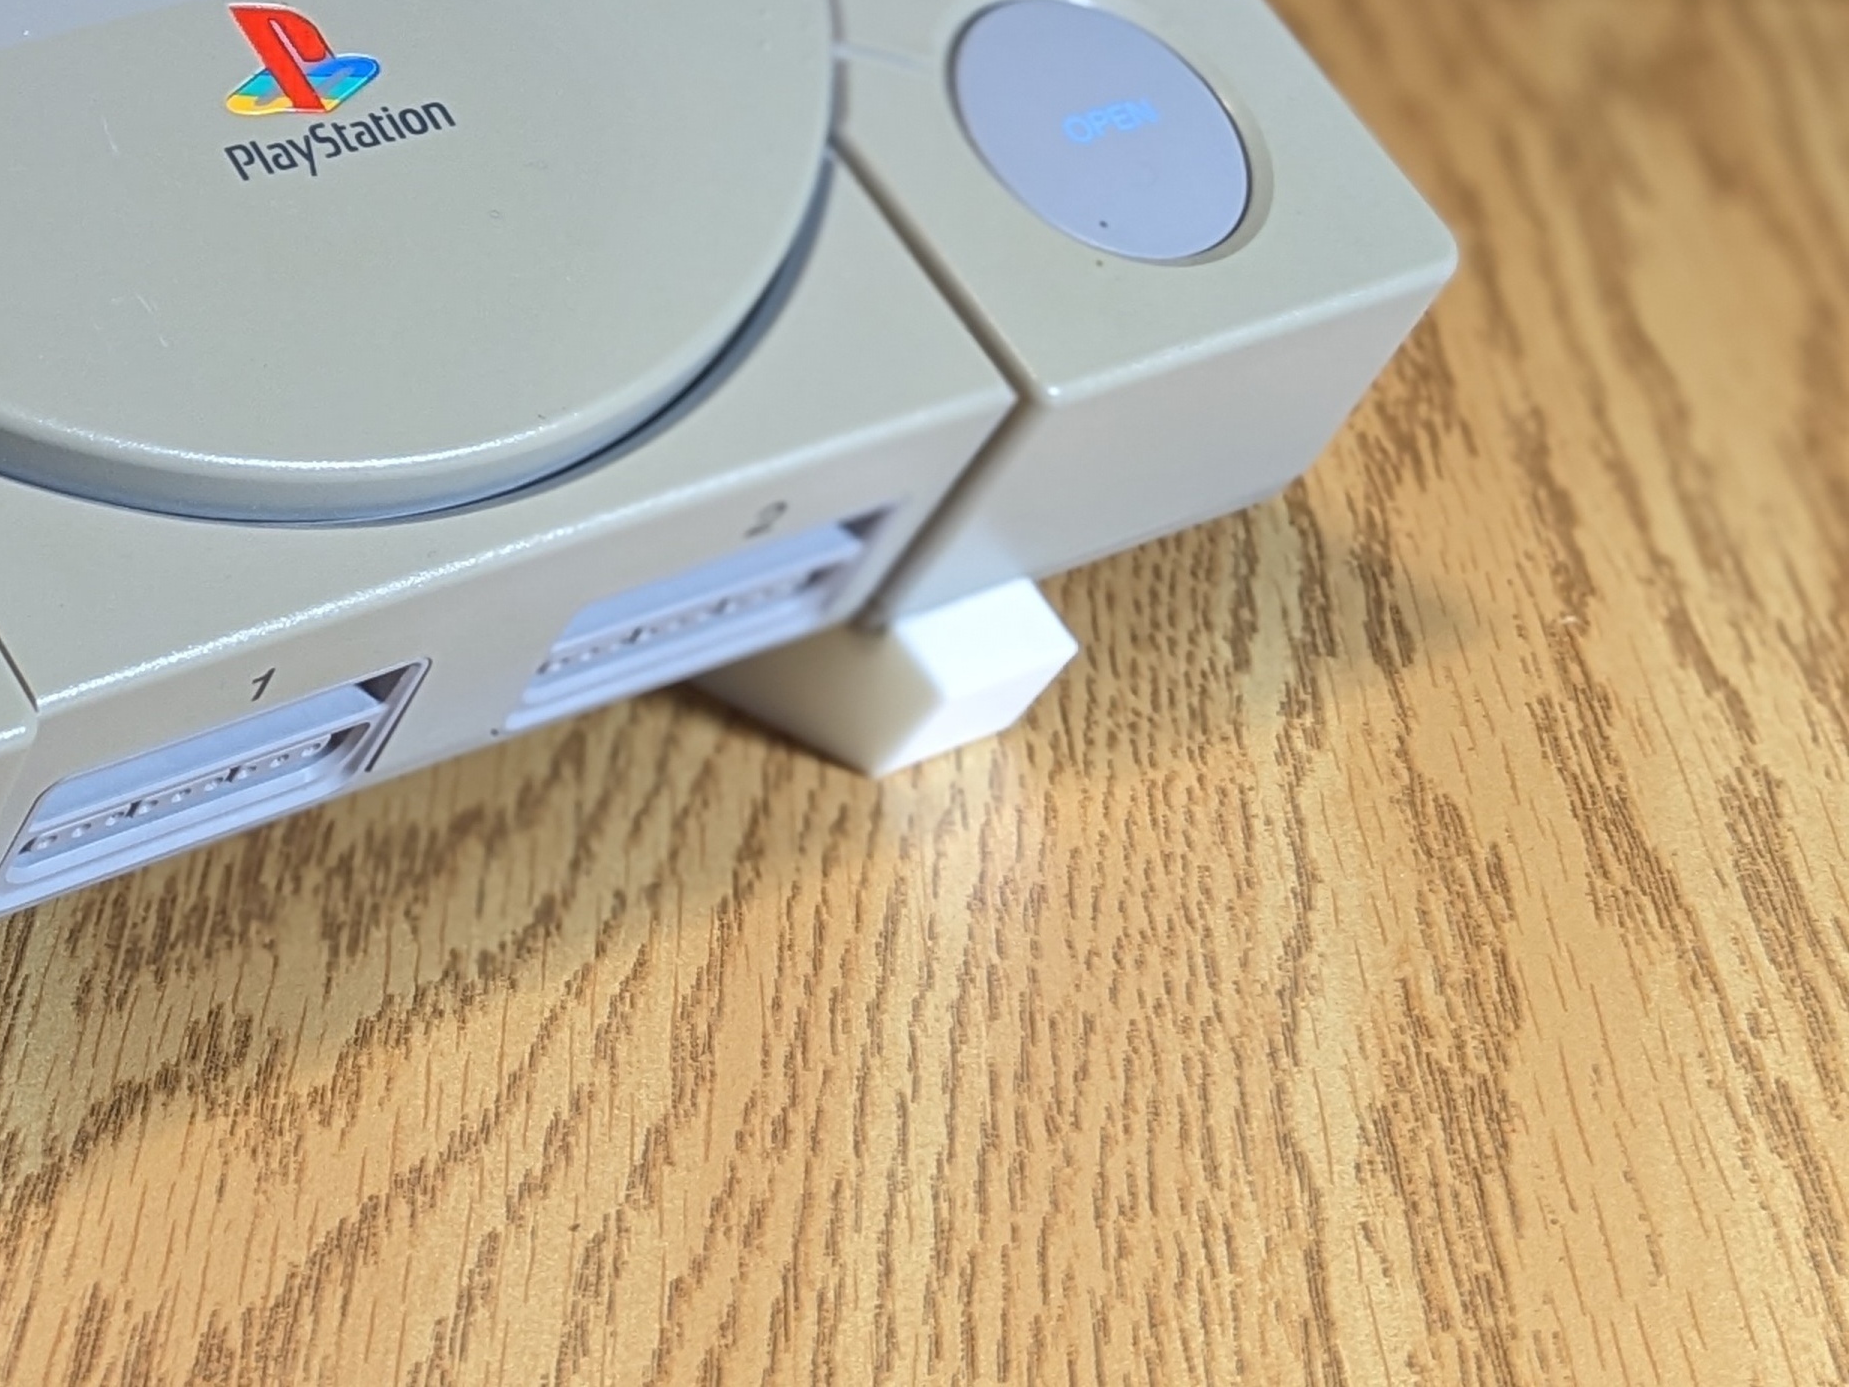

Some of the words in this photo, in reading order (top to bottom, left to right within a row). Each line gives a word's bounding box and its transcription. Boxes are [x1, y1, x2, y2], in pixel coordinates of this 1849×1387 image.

[223, 101, 457, 181] PlayStation
[1061, 98, 1160, 144] OPEN
[744, 499, 788, 540] 2
[251, 667, 276, 702] 1
